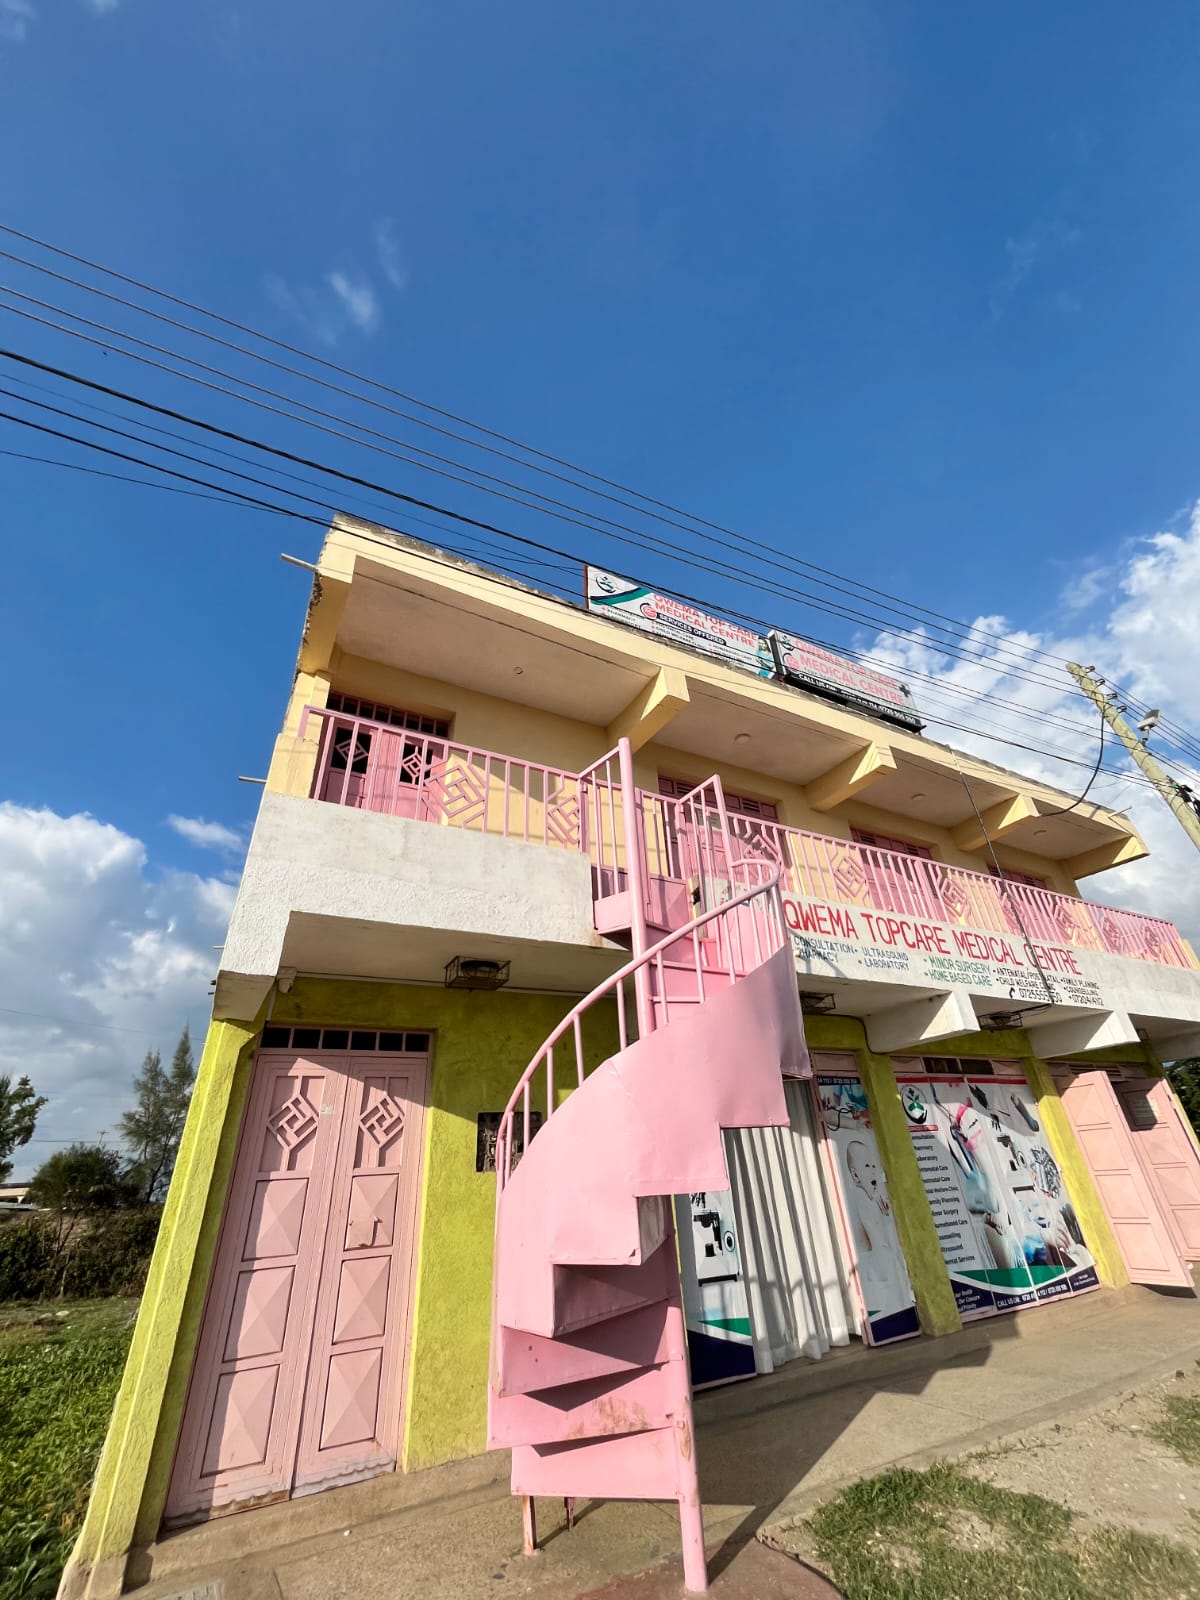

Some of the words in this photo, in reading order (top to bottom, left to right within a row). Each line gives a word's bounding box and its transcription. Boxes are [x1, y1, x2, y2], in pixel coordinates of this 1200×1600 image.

[655, 602, 707, 630] MEDICAL
[710, 625, 755, 647] CENTRE
[660, 615, 692, 632] SERVICES
[694, 629, 724, 644] OFFERED
[800, 656, 858, 687] MEDICAL
[859, 680, 904, 705] CENTRE
[783, 899, 859, 940] QWEMA
[861, 912, 951, 955] TOPCARE
[952, 929, 1024, 966] MEDICAL
[1023, 943, 1082, 976] CENTRE
[863, 957, 909, 971] LABORATORY
[929, 956, 956, 970] MINOR
[955, 960, 991, 975] SURGERY
[972, 974, 992, 986] CARE
